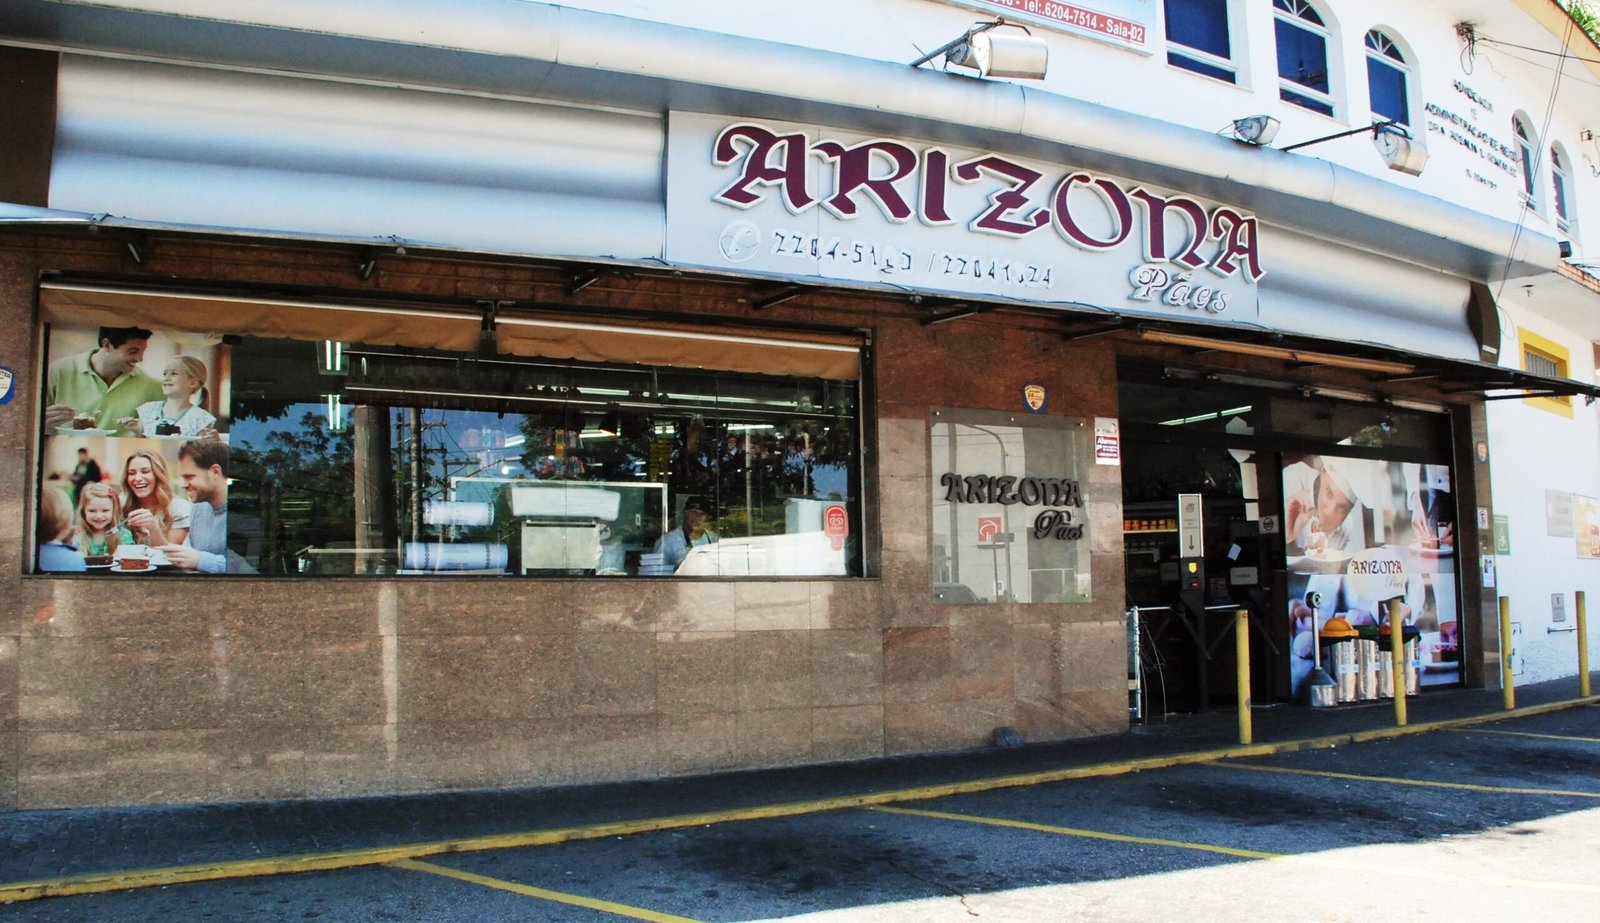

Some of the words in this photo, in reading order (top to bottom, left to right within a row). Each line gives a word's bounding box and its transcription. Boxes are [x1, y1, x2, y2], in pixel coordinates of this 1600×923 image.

[1106, 19, 1143, 41] Sala-02
[713, 123, 1266, 283] ARIZONA
[940, 472, 1084, 508] ARIZONA
[1351, 560, 1403, 574] ARIZONA
